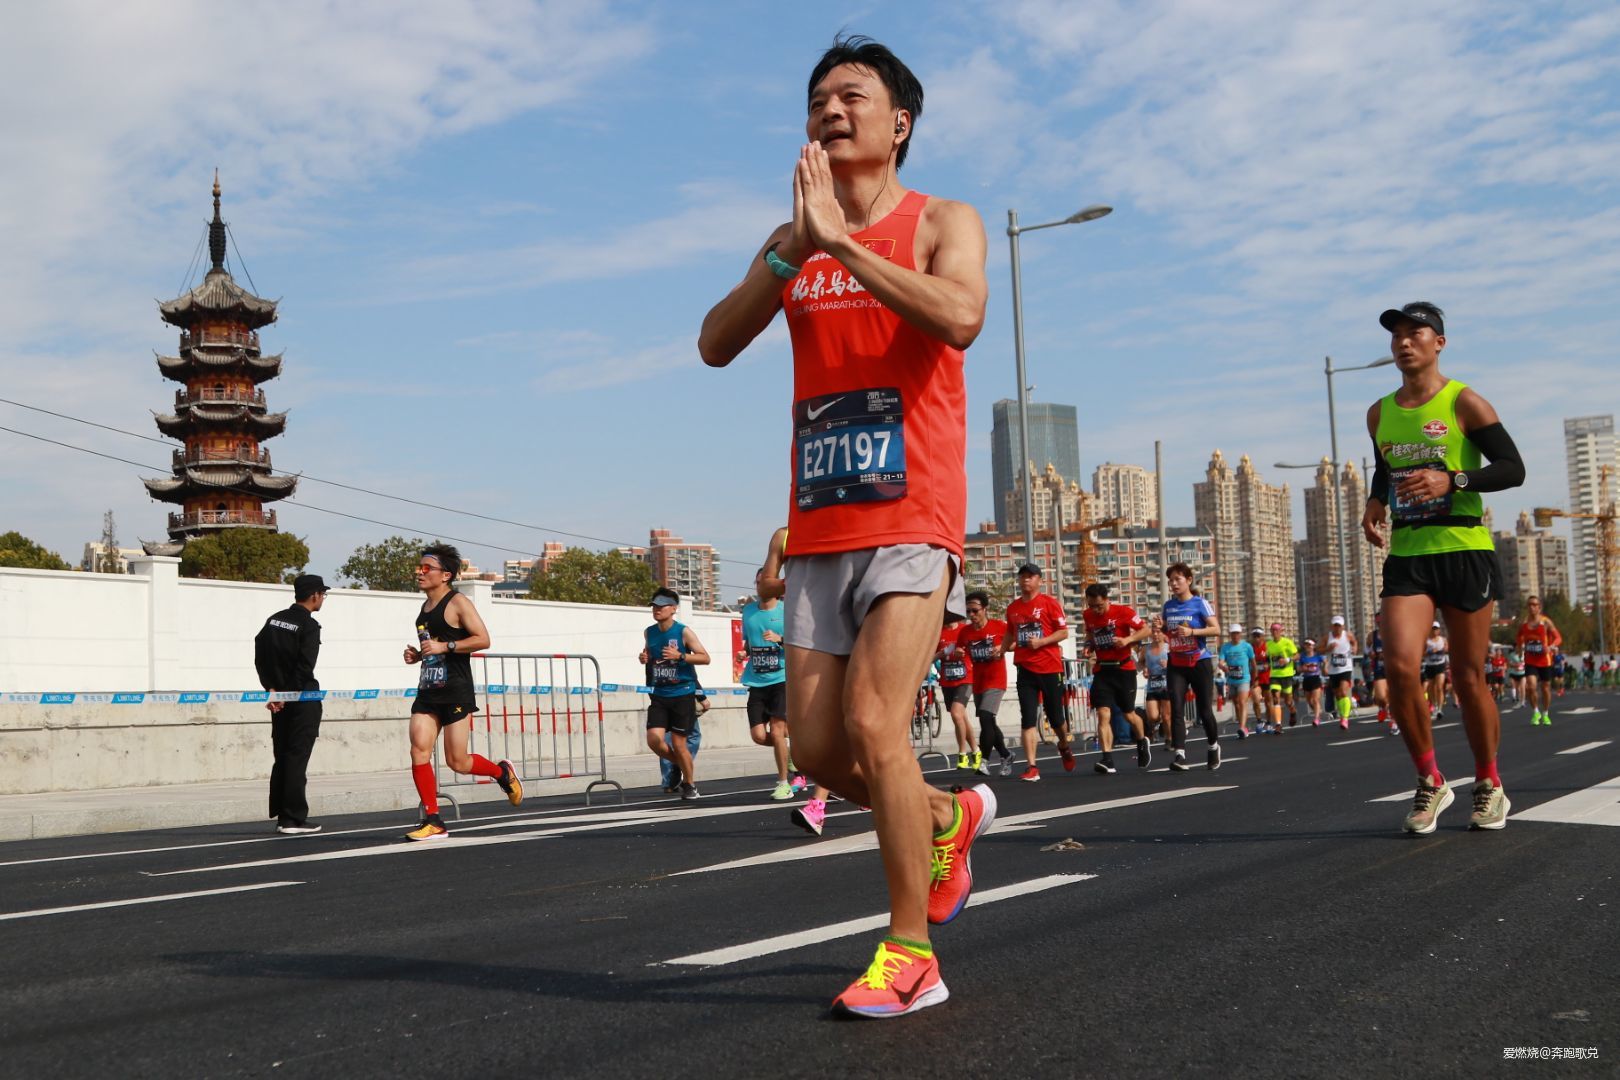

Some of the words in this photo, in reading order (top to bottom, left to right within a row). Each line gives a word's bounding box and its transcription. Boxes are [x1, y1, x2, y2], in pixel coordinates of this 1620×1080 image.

[820, 299, 868, 311] MARATHON
[804, 431, 891, 480] E27197
[752, 656, 779, 667] D25489
